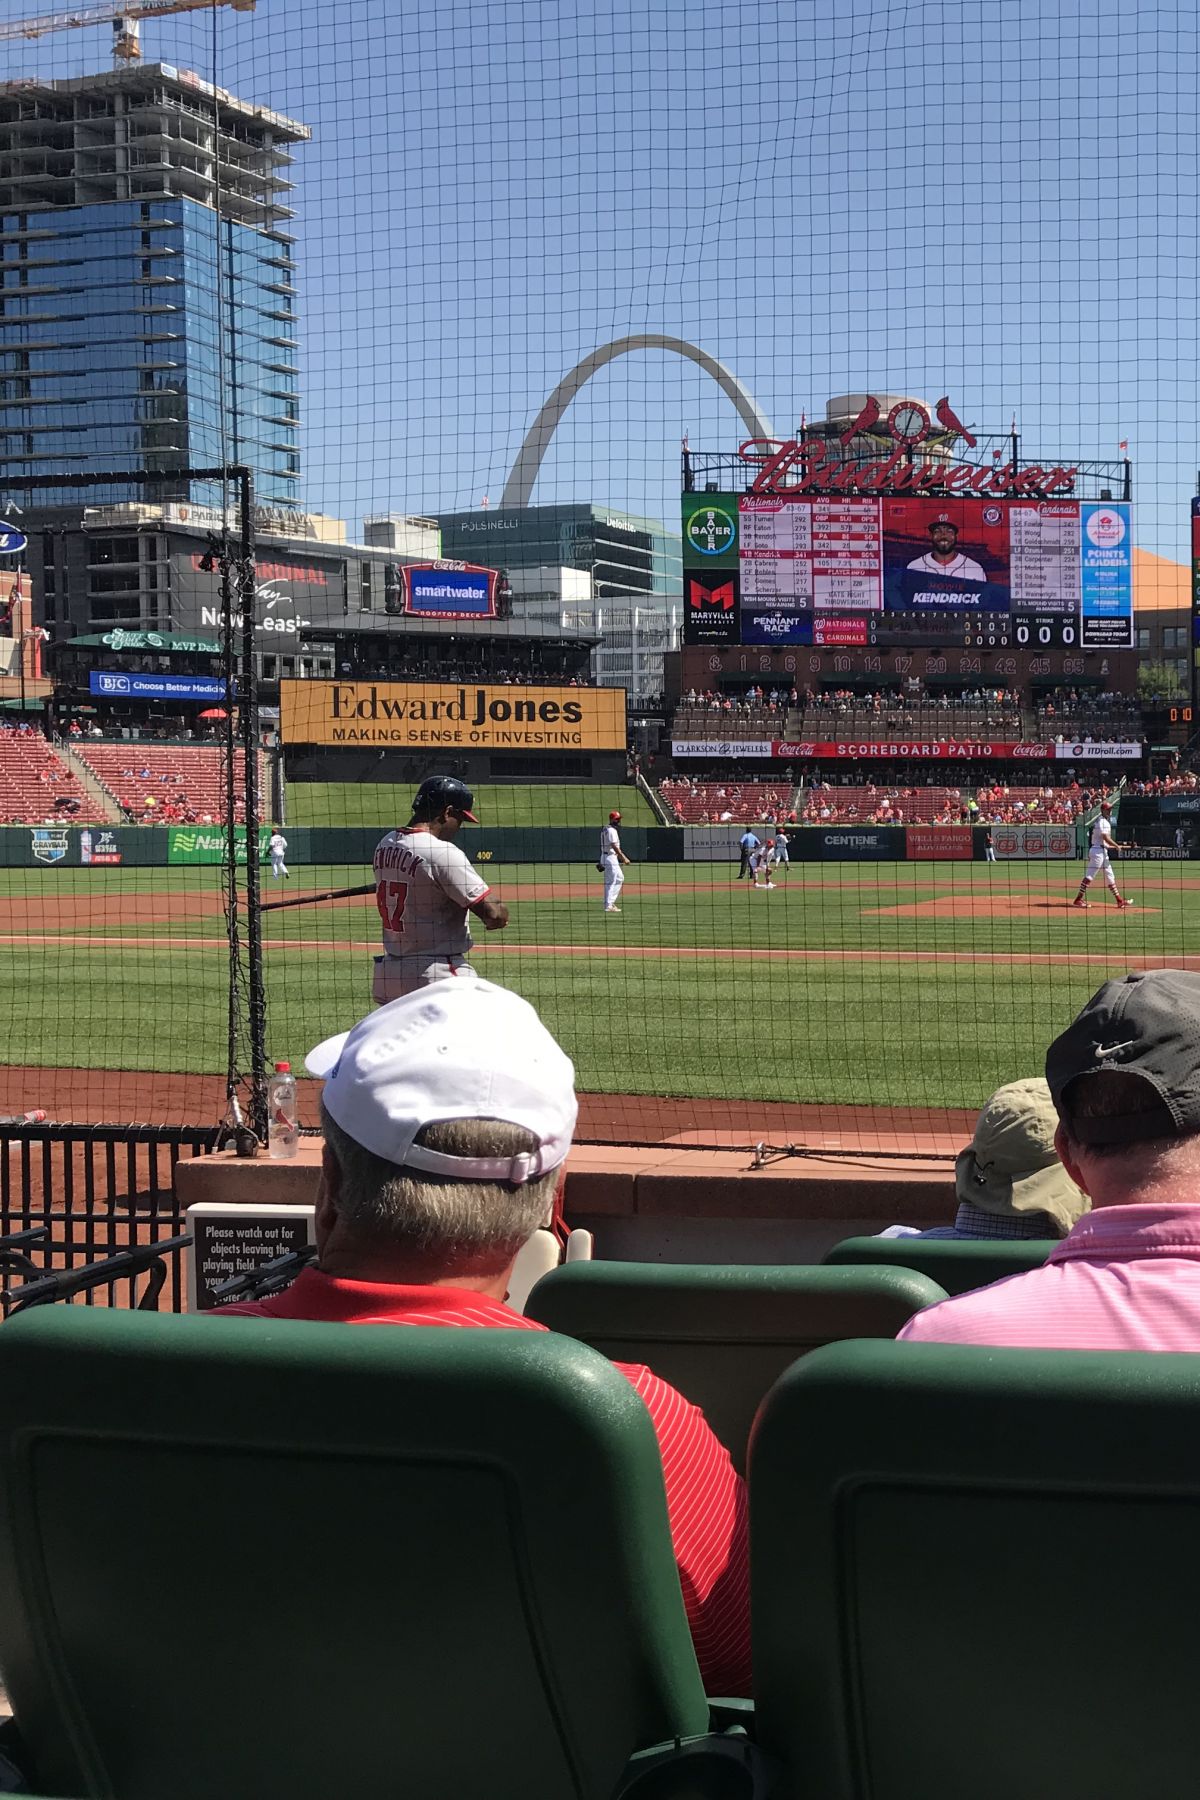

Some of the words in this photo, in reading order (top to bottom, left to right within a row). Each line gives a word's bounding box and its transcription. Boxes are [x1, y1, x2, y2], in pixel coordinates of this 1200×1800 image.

[739, 437, 1078, 495] Budweiser
[741, 496, 784, 509] Nationals
[1037, 501, 1077, 514] Cardinals
[461, 519, 519, 532] POLSINELLI
[691, 526, 731, 535] BAYER
[1087, 550, 1125, 559] POINTS
[1084, 558, 1129, 567] LEADERS
[415, 586, 486, 600] smartwater
[912, 593, 981, 604] KENDRICK
[690, 611, 735, 619] MARYVILLE
[753, 617, 801, 626] PENNANT
[763, 625, 791, 634] RACE
[826, 621, 865, 629] NATIONALS
[1016, 626, 1029, 643] 0
[1038, 626, 1051, 643] 0
[1062, 626, 1075, 643] 0
[171, 641, 197, 652] MVP
[834, 655, 851, 672] 10
[864, 655, 882, 672] 14
[895, 655, 913, 672] 17
[925, 657, 947, 672] 20
[959, 657, 982, 674] 24
[995, 657, 1017, 674] 42
[1029, 657, 1051, 674] 45
[1063, 657, 1085, 674] 85
[103, 677, 127, 690] BJC
[133, 681, 164, 691] Choose
[165, 683, 191, 692] Better
[192, 683, 226, 694] Medicin
[329, 685, 469, 723] Edward
[471, 689, 583, 726] Jones
[332, 728, 401, 742] MAKING
[408, 729, 464, 743] SENSE
[469, 730, 491, 743] OF
[496, 731, 583, 745] INVESTING
[676, 745, 718, 753] CLARKSON
[732, 744, 769, 753] JEWELERS
[777, 743, 817, 756] Coca-Cola
[837, 744, 942, 755] SCOREBOARD
[948, 745, 993, 755] PATIO
[1013, 744, 1048, 757] Coca-Cola
[33, 841, 66, 849] GRAYBAR
[824, 835, 878, 846] CENTENE
[476, 850, 493, 860] 400'
[1117, 850, 1147, 859] BUSCH
[1149, 850, 1190, 859] STADIUM
[376, 880, 408, 932] 47
[205, 1226, 234, 1239] Please
[236, 1226, 263, 1239] watch
[264, 1228, 279, 1239] out
[281, 1227, 295, 1239] for
[211, 1242, 241, 1256] objects
[242, 1242, 274, 1258] leaving
[275, 1243, 290, 1255] the
[202, 1258, 234, 1273] playing
